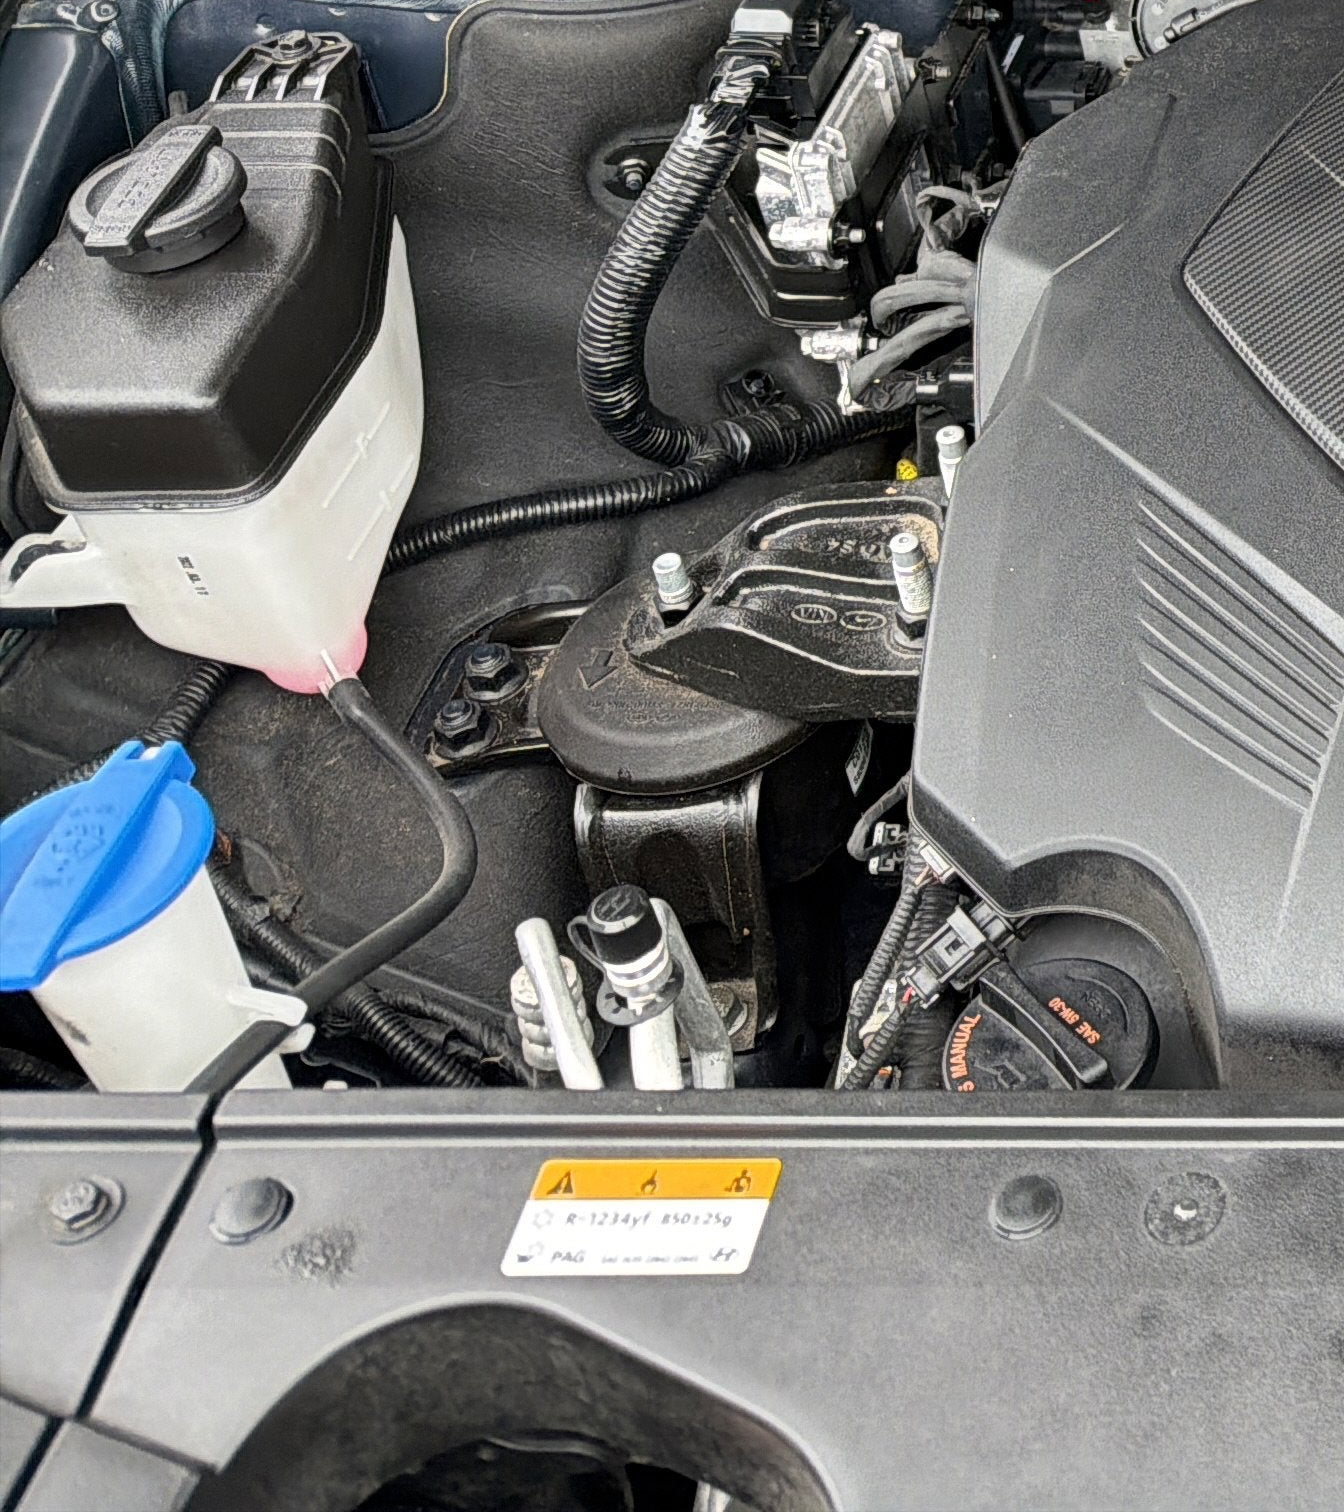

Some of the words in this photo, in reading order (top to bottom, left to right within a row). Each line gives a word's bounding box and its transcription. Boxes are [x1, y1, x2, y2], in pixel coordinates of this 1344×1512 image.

[1075, 1020, 1102, 1046] SAE
[950, 1015, 982, 1079] MANUAL
[566, 1211, 651, 1231] R-1234yf
[551, 1251, 587, 1264] PAG
